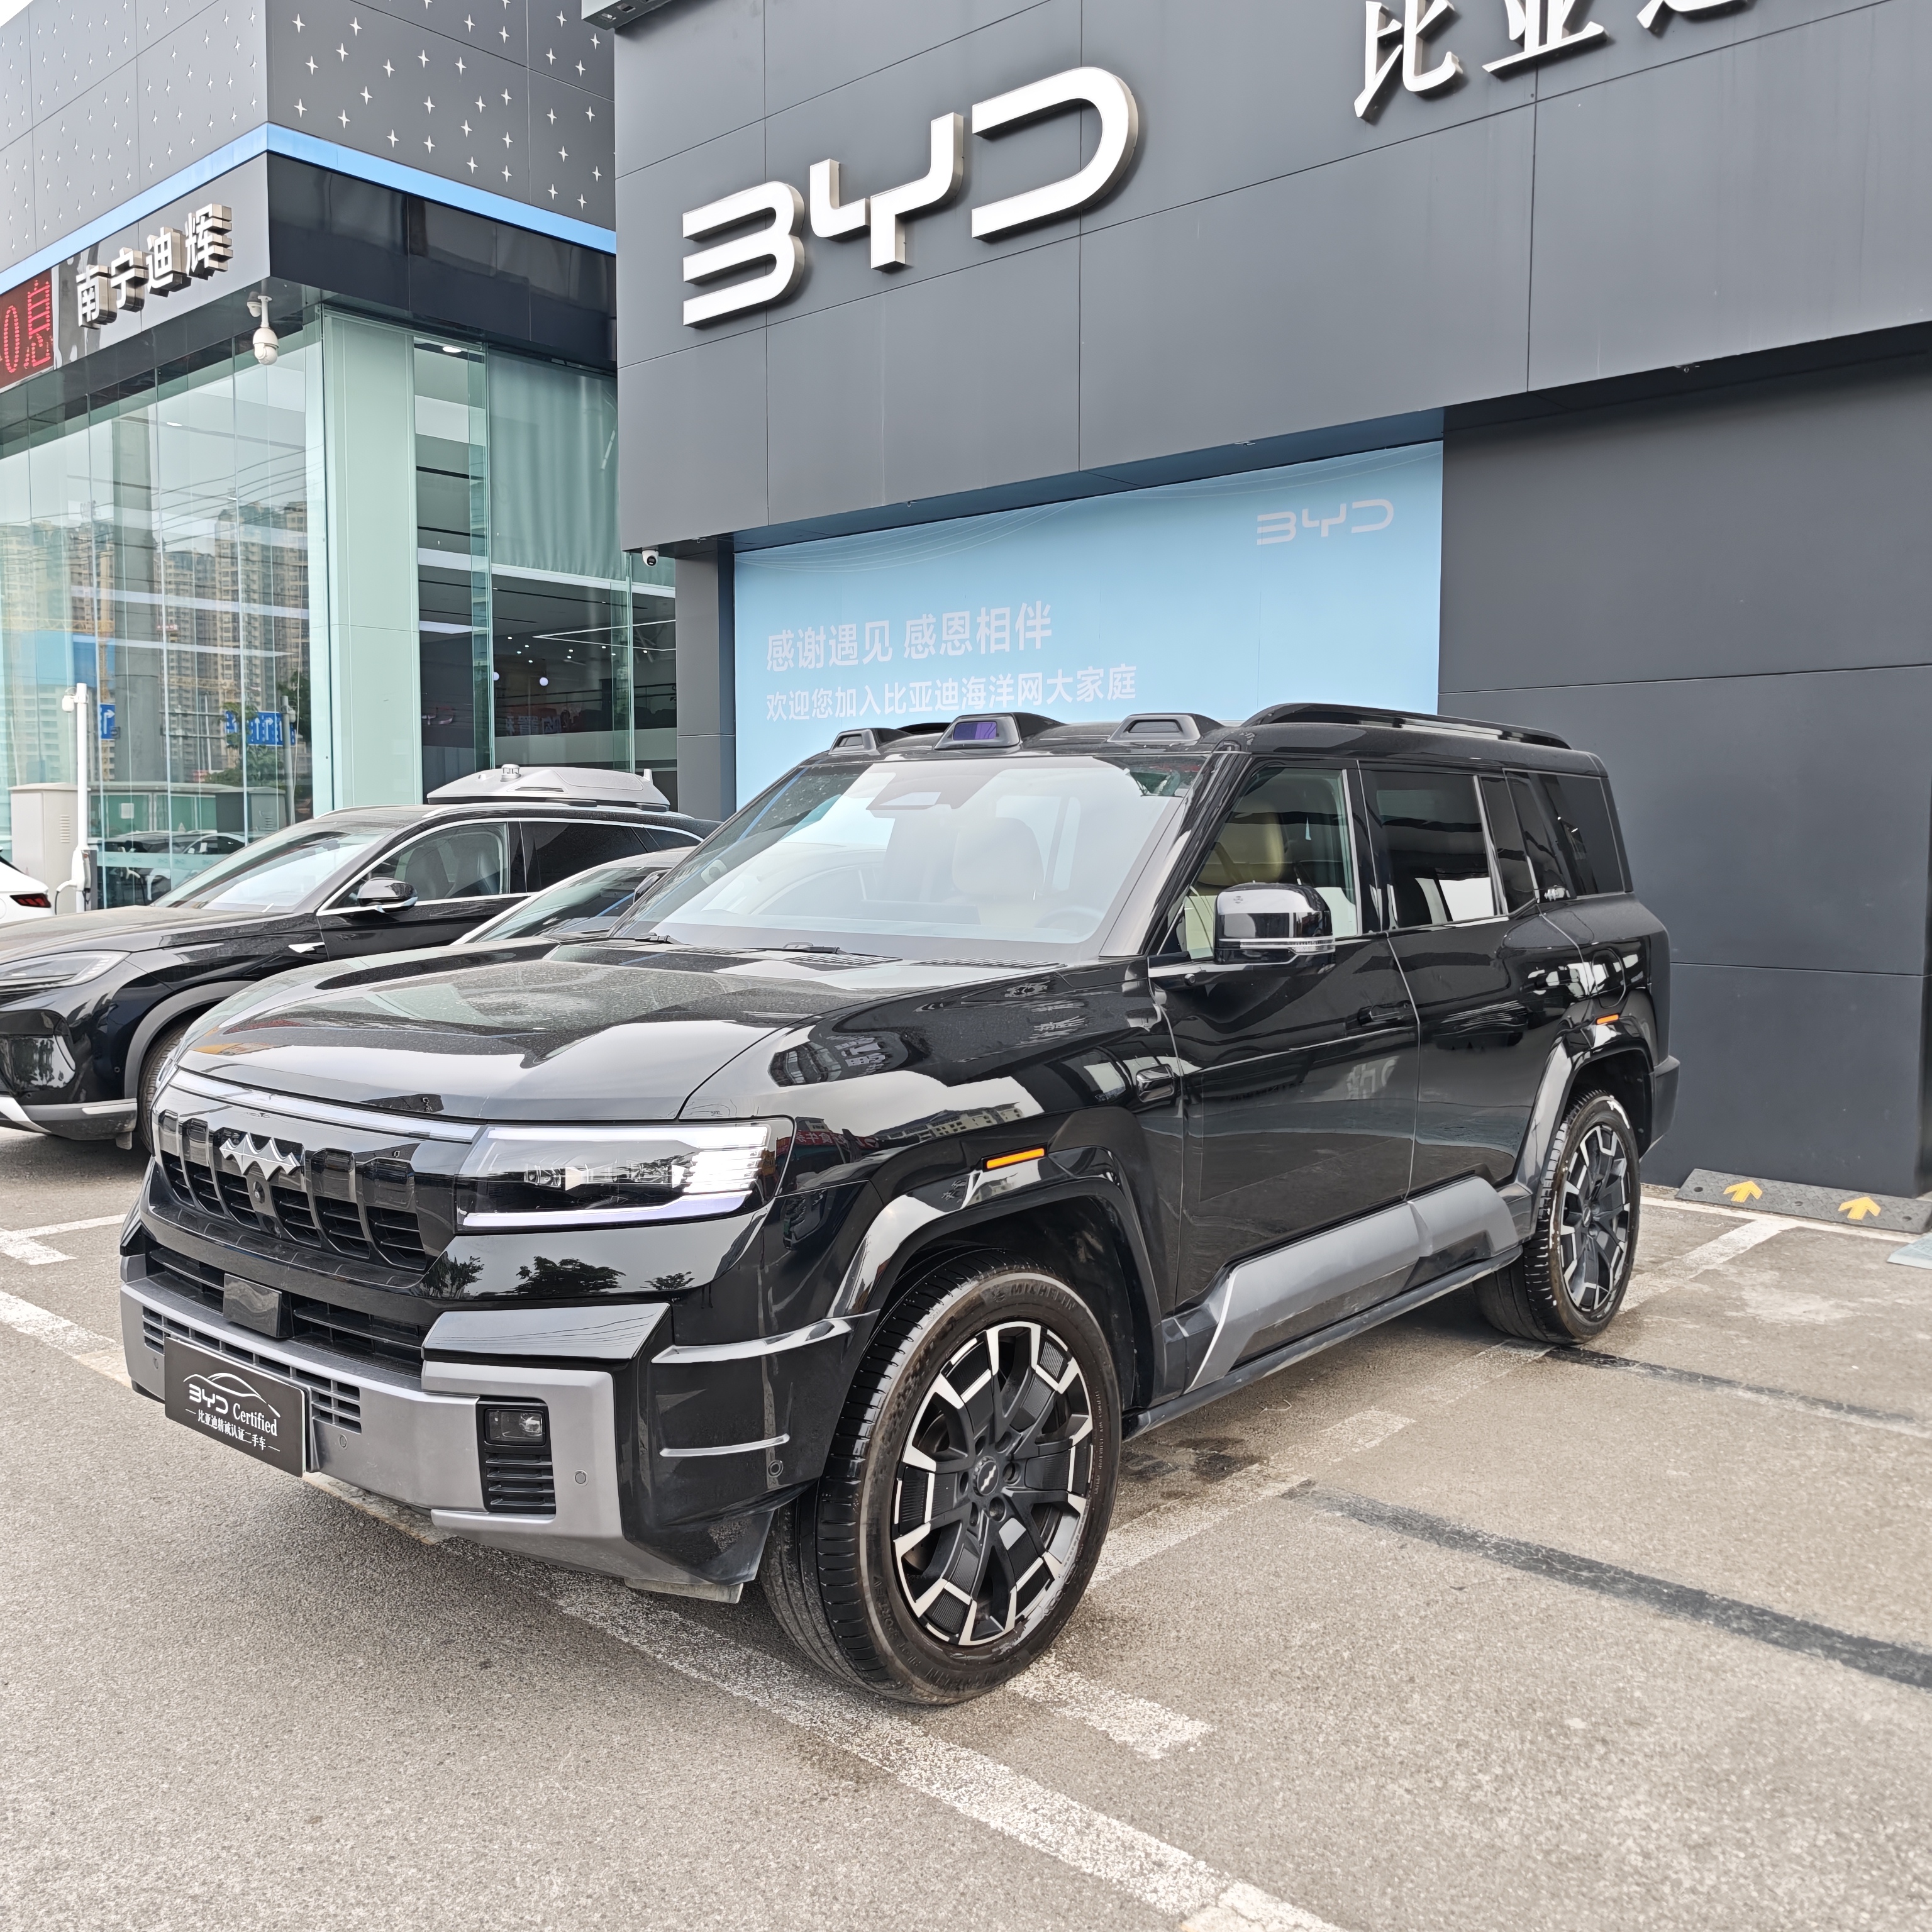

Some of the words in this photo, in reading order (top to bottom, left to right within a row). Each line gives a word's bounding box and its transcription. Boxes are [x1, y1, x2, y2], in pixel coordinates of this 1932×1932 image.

[1354, 0, 1758, 118] 比亚
[683, 66, 1138, 328] BYD
[76, 203, 231, 328] 南宁迪辉
[1257, 499, 1394, 545] BYD
[766, 620, 893, 672] 感谢遇见
[903, 600, 1052, 660] 感恩相伴
[766, 663, 1137, 723] 欢迎您加入比亚迪海洋网大家庭
[189, 1383, 228, 1414] BYD
[233, 1403, 278, 1436] Certified
[197, 1409, 267, 1451] 比亚迪精诚认证二手车
